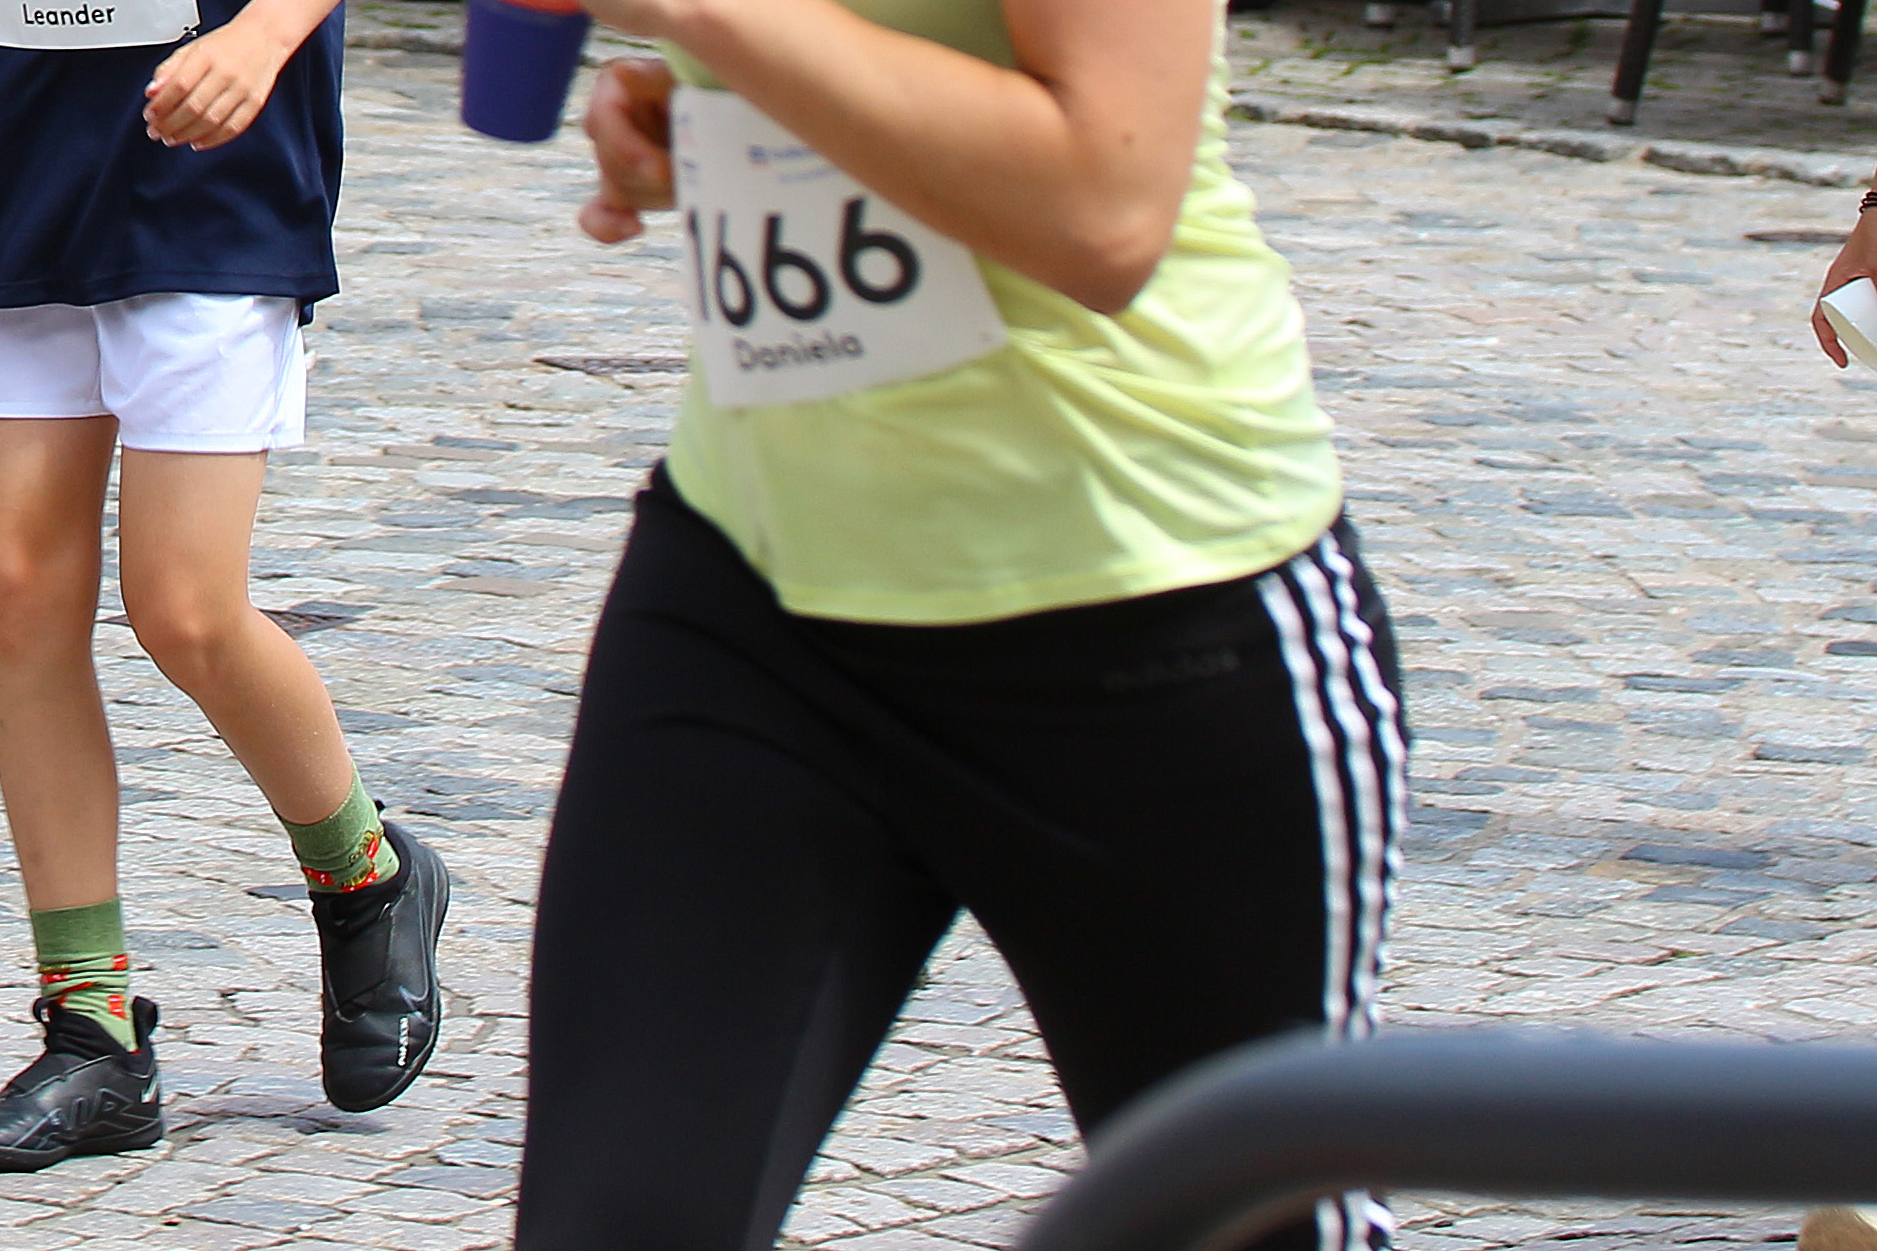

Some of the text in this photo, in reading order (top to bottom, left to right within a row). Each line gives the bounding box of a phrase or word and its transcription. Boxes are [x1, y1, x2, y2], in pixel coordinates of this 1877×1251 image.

[23, 3, 116, 26] Leander
[687, 194, 921, 328] 1666
[733, 331, 865, 371] Daniela
